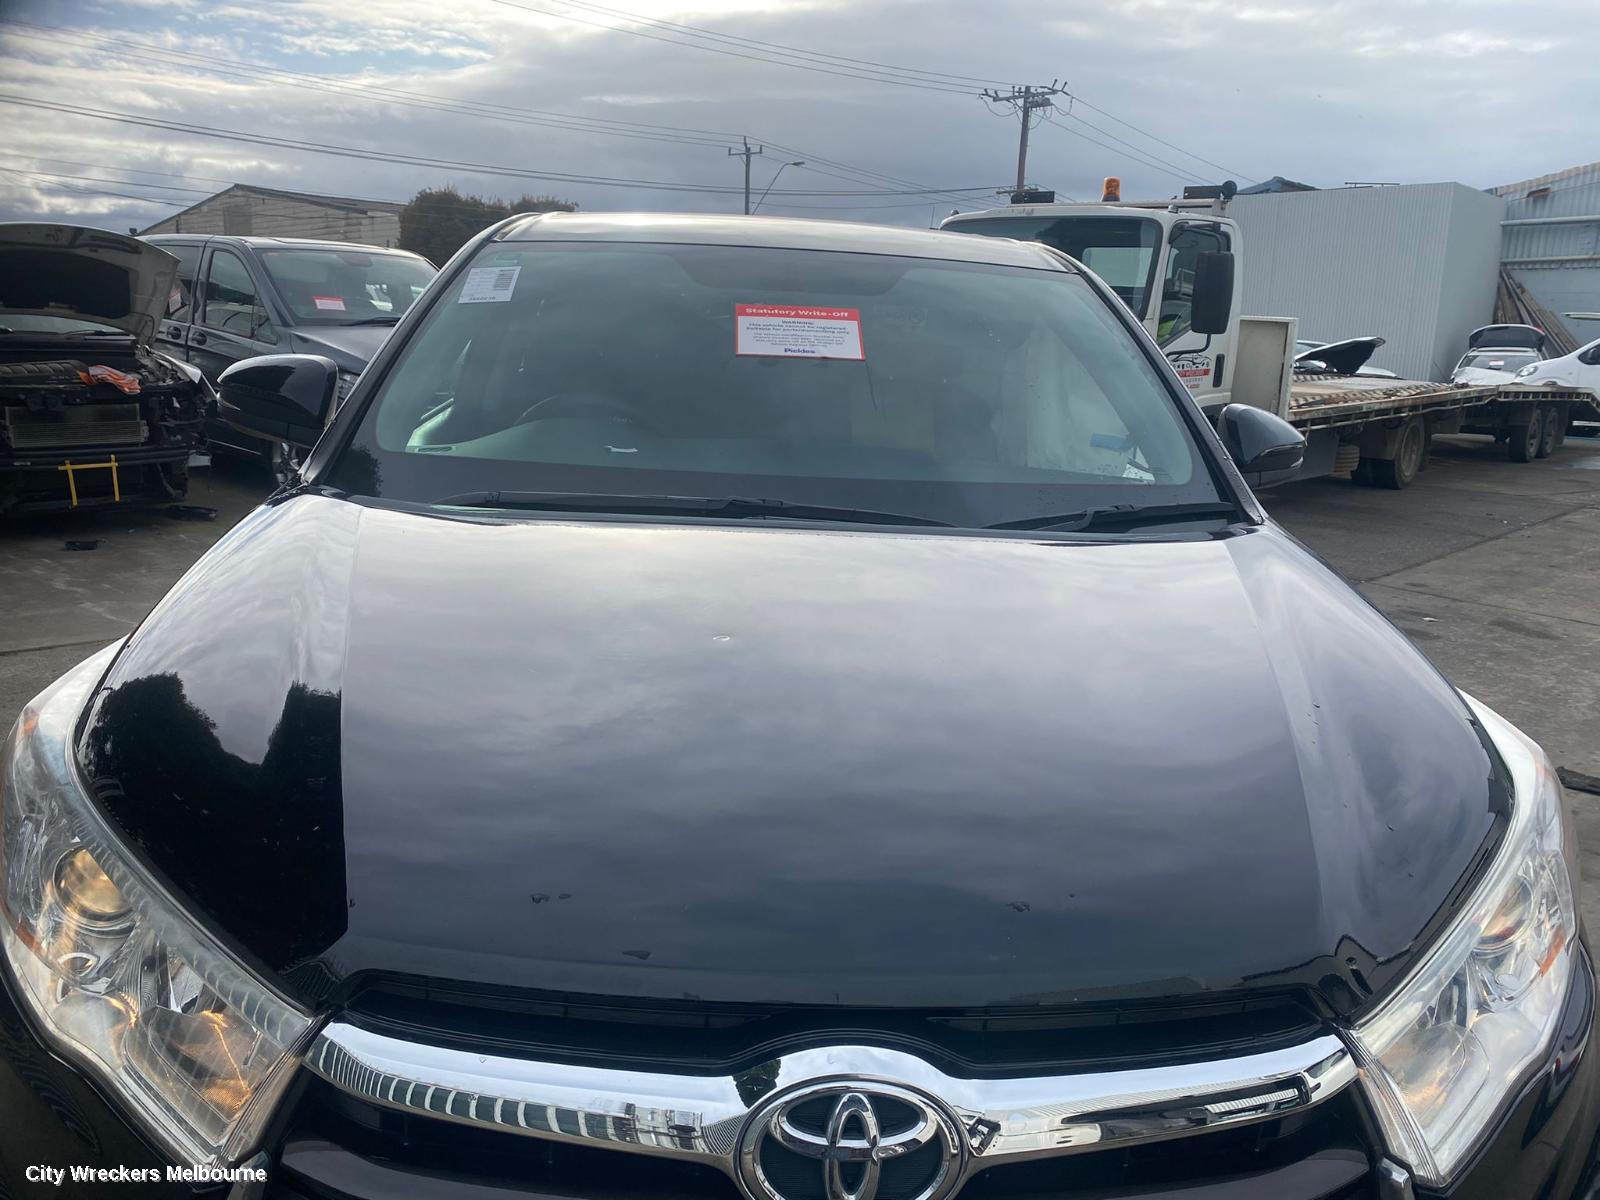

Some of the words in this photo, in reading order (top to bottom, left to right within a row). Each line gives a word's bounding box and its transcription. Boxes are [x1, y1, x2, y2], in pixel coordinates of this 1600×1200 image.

[745, 307, 796, 316] Statutory
[798, 309, 849, 318] Write-Off
[784, 347, 816, 355] Pickles
